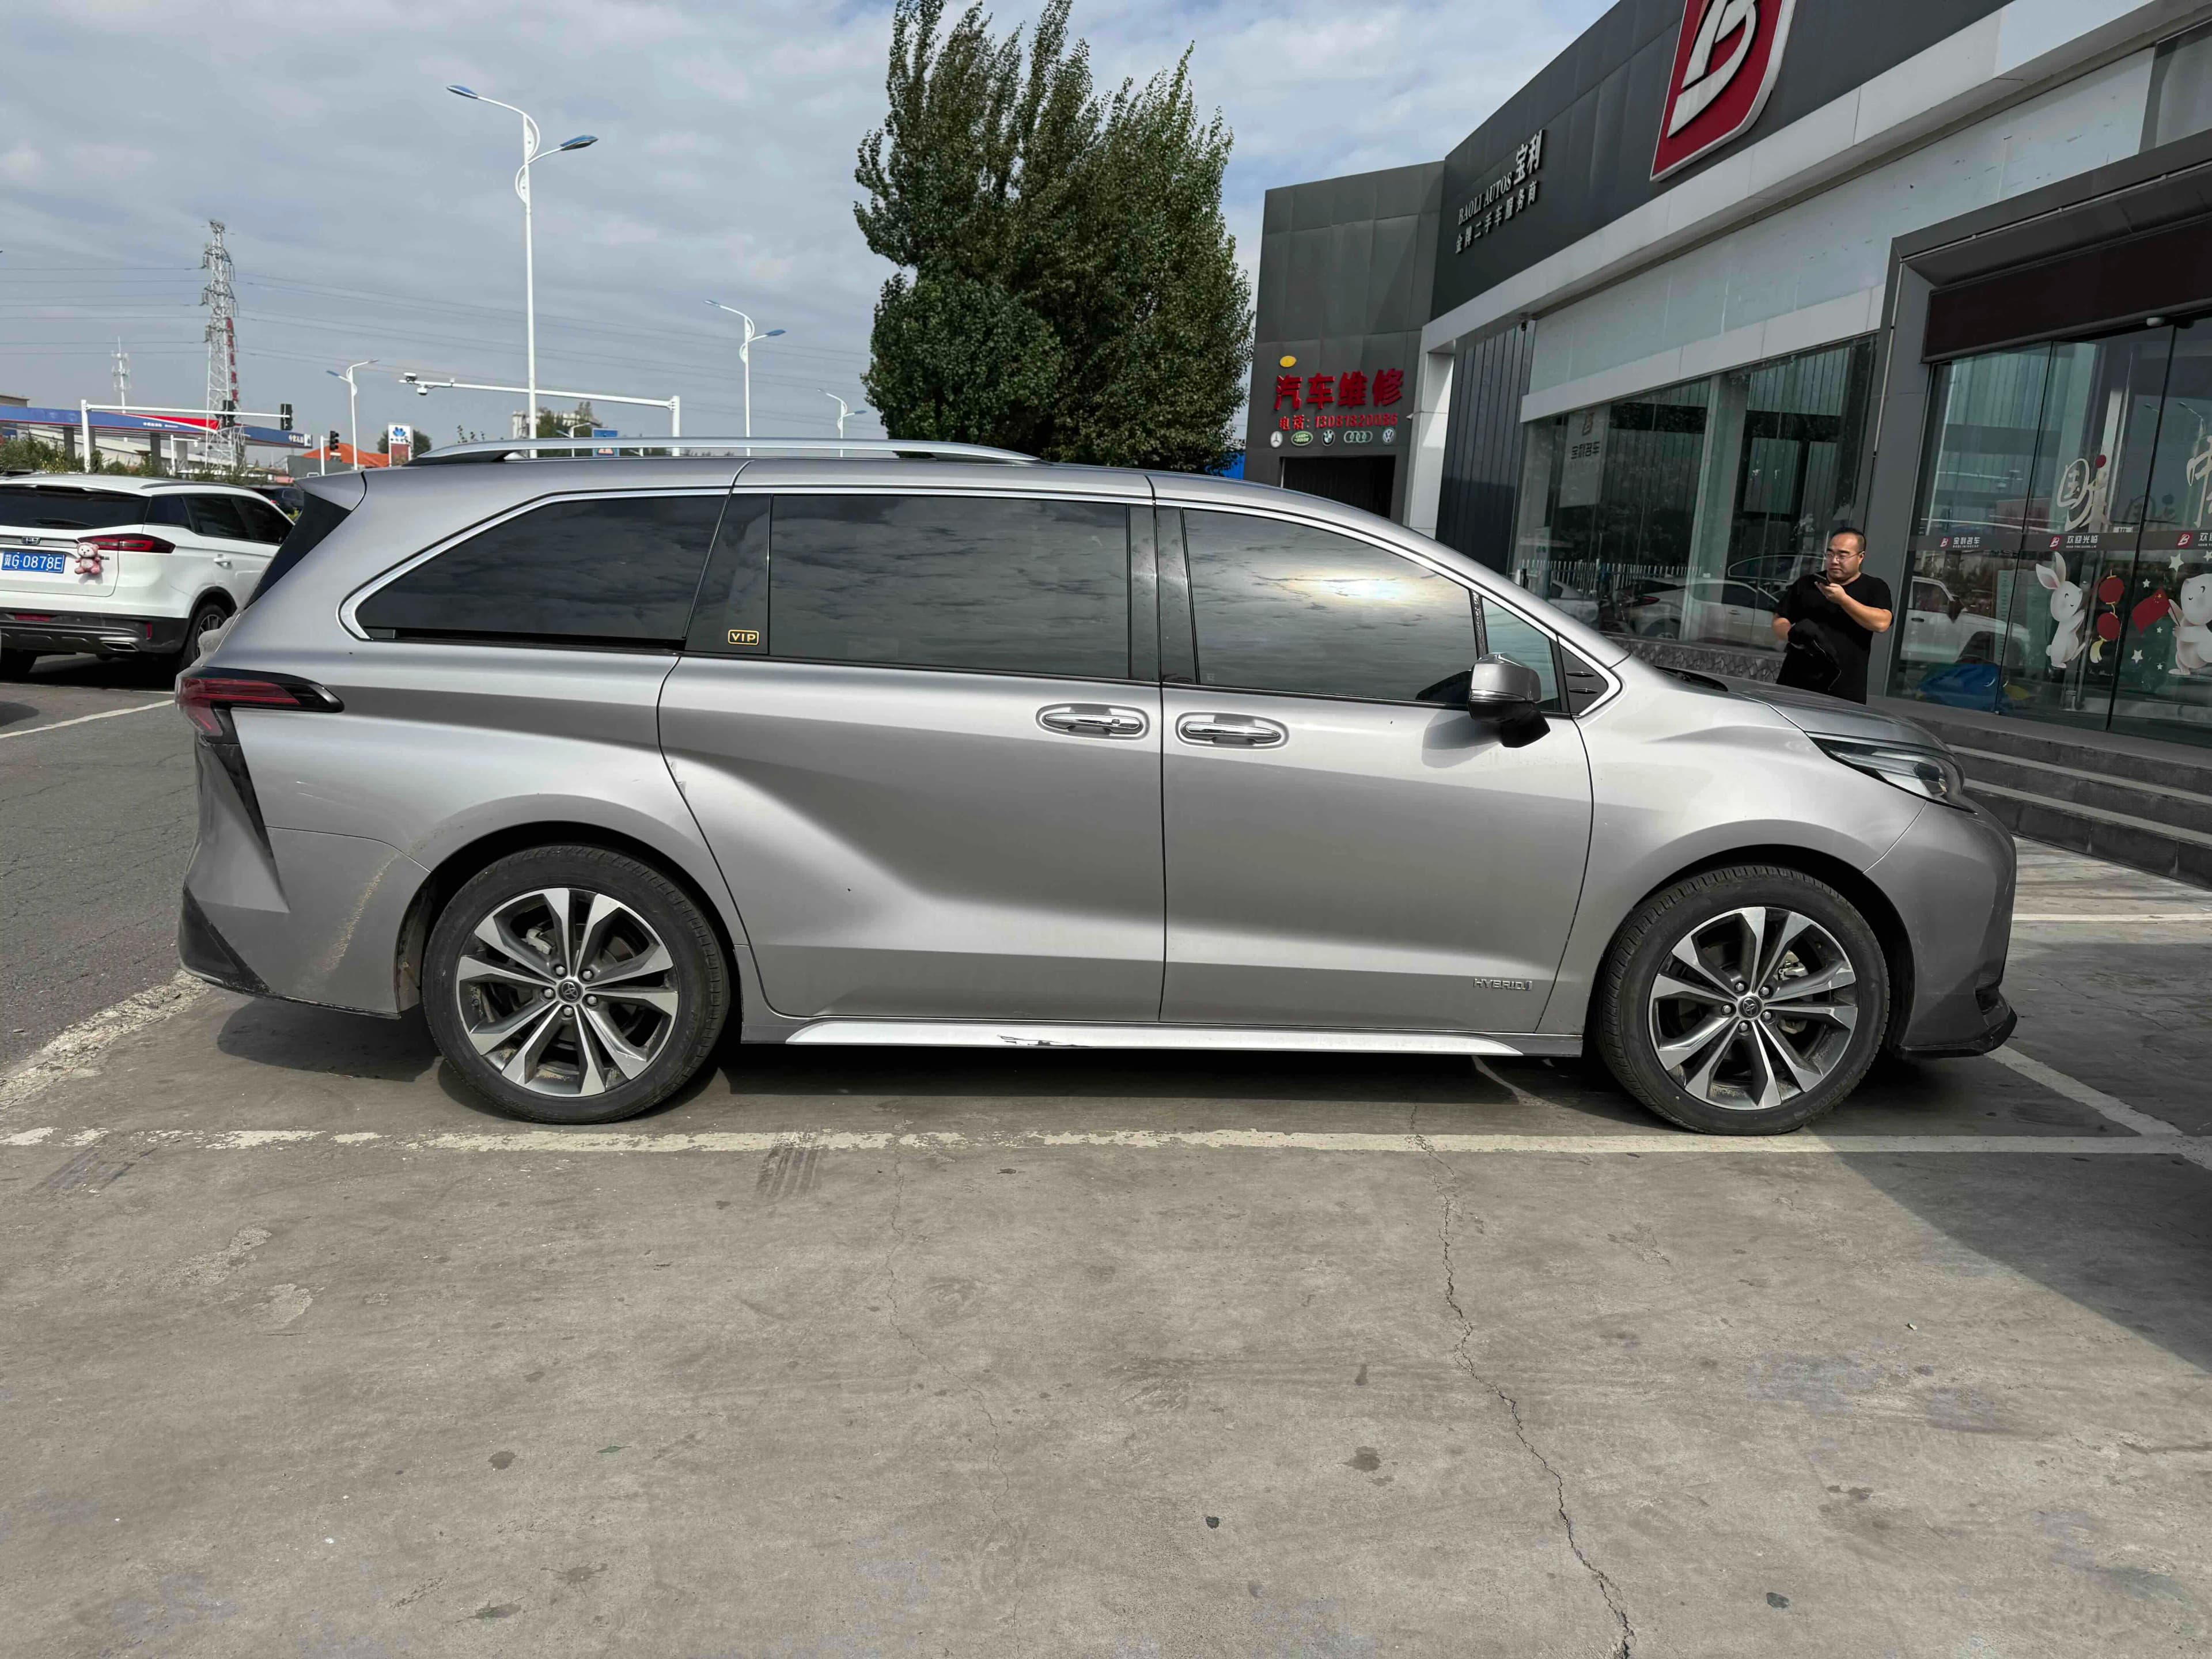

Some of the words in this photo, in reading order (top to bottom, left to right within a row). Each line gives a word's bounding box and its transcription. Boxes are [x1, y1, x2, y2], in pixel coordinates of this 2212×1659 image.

[1458, 193, 1482, 226] BAOLI
[1483, 171, 1513, 208] AUTOS
[1513, 128, 1546, 185] 宝利
[1455, 180, 1538, 254] 金牌二手车服务商
[1274, 368, 1404, 411] 汽车维修
[2066, 535, 2099, 544] 欢迎光临
[731, 632, 756, 642] VIP
[1473, 978, 1525, 991] HYBRID
